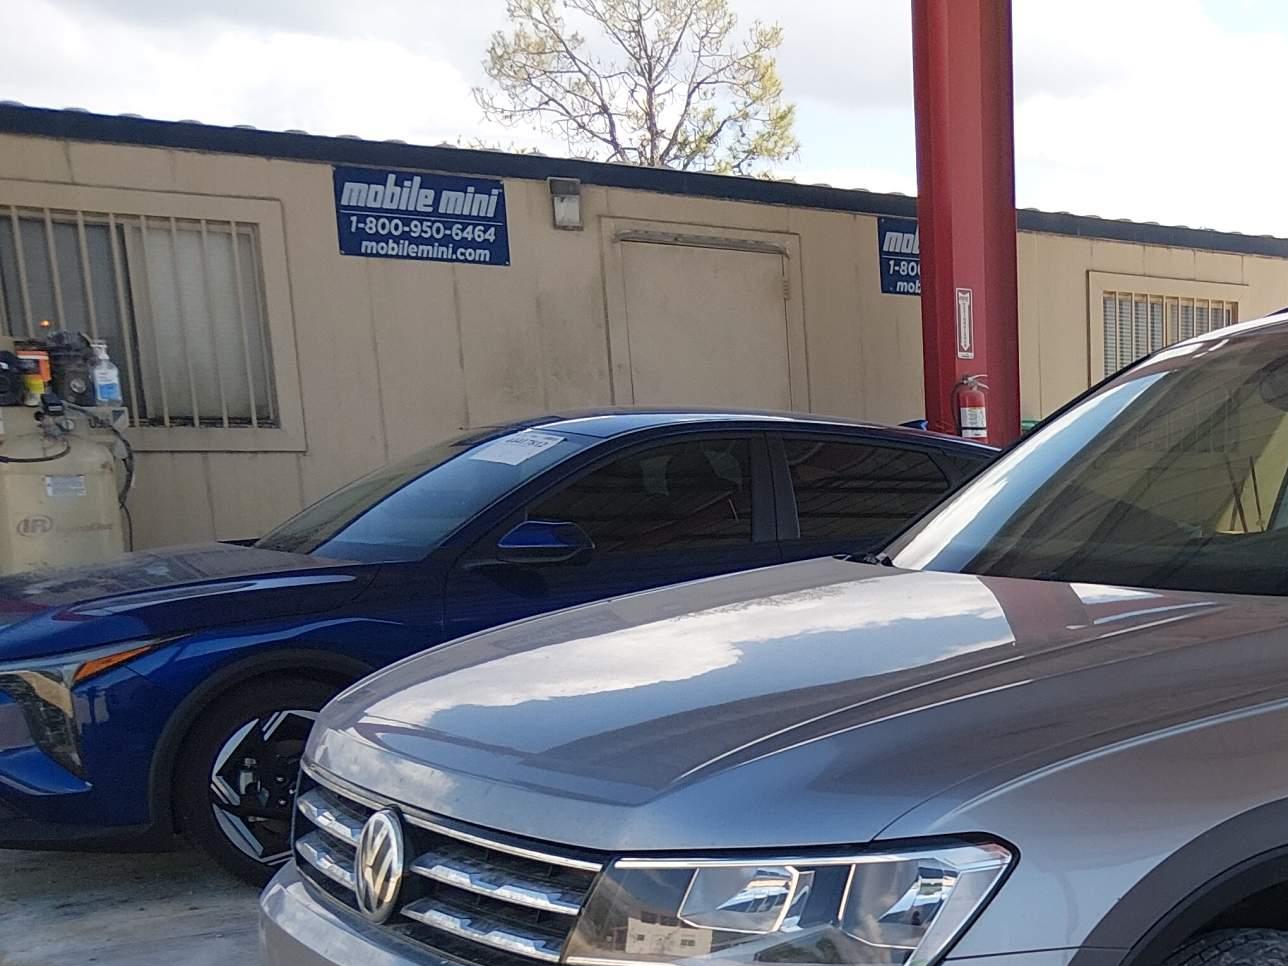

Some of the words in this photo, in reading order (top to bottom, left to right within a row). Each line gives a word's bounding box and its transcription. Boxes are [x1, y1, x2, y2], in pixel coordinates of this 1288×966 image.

[340, 173, 435, 212] mobile
[438, 186, 499, 217] mini
[350, 215, 496, 243] 1-800-950-6464
[361, 239, 491, 262] mobilemini.com
[889, 260, 920, 276] 1-80
